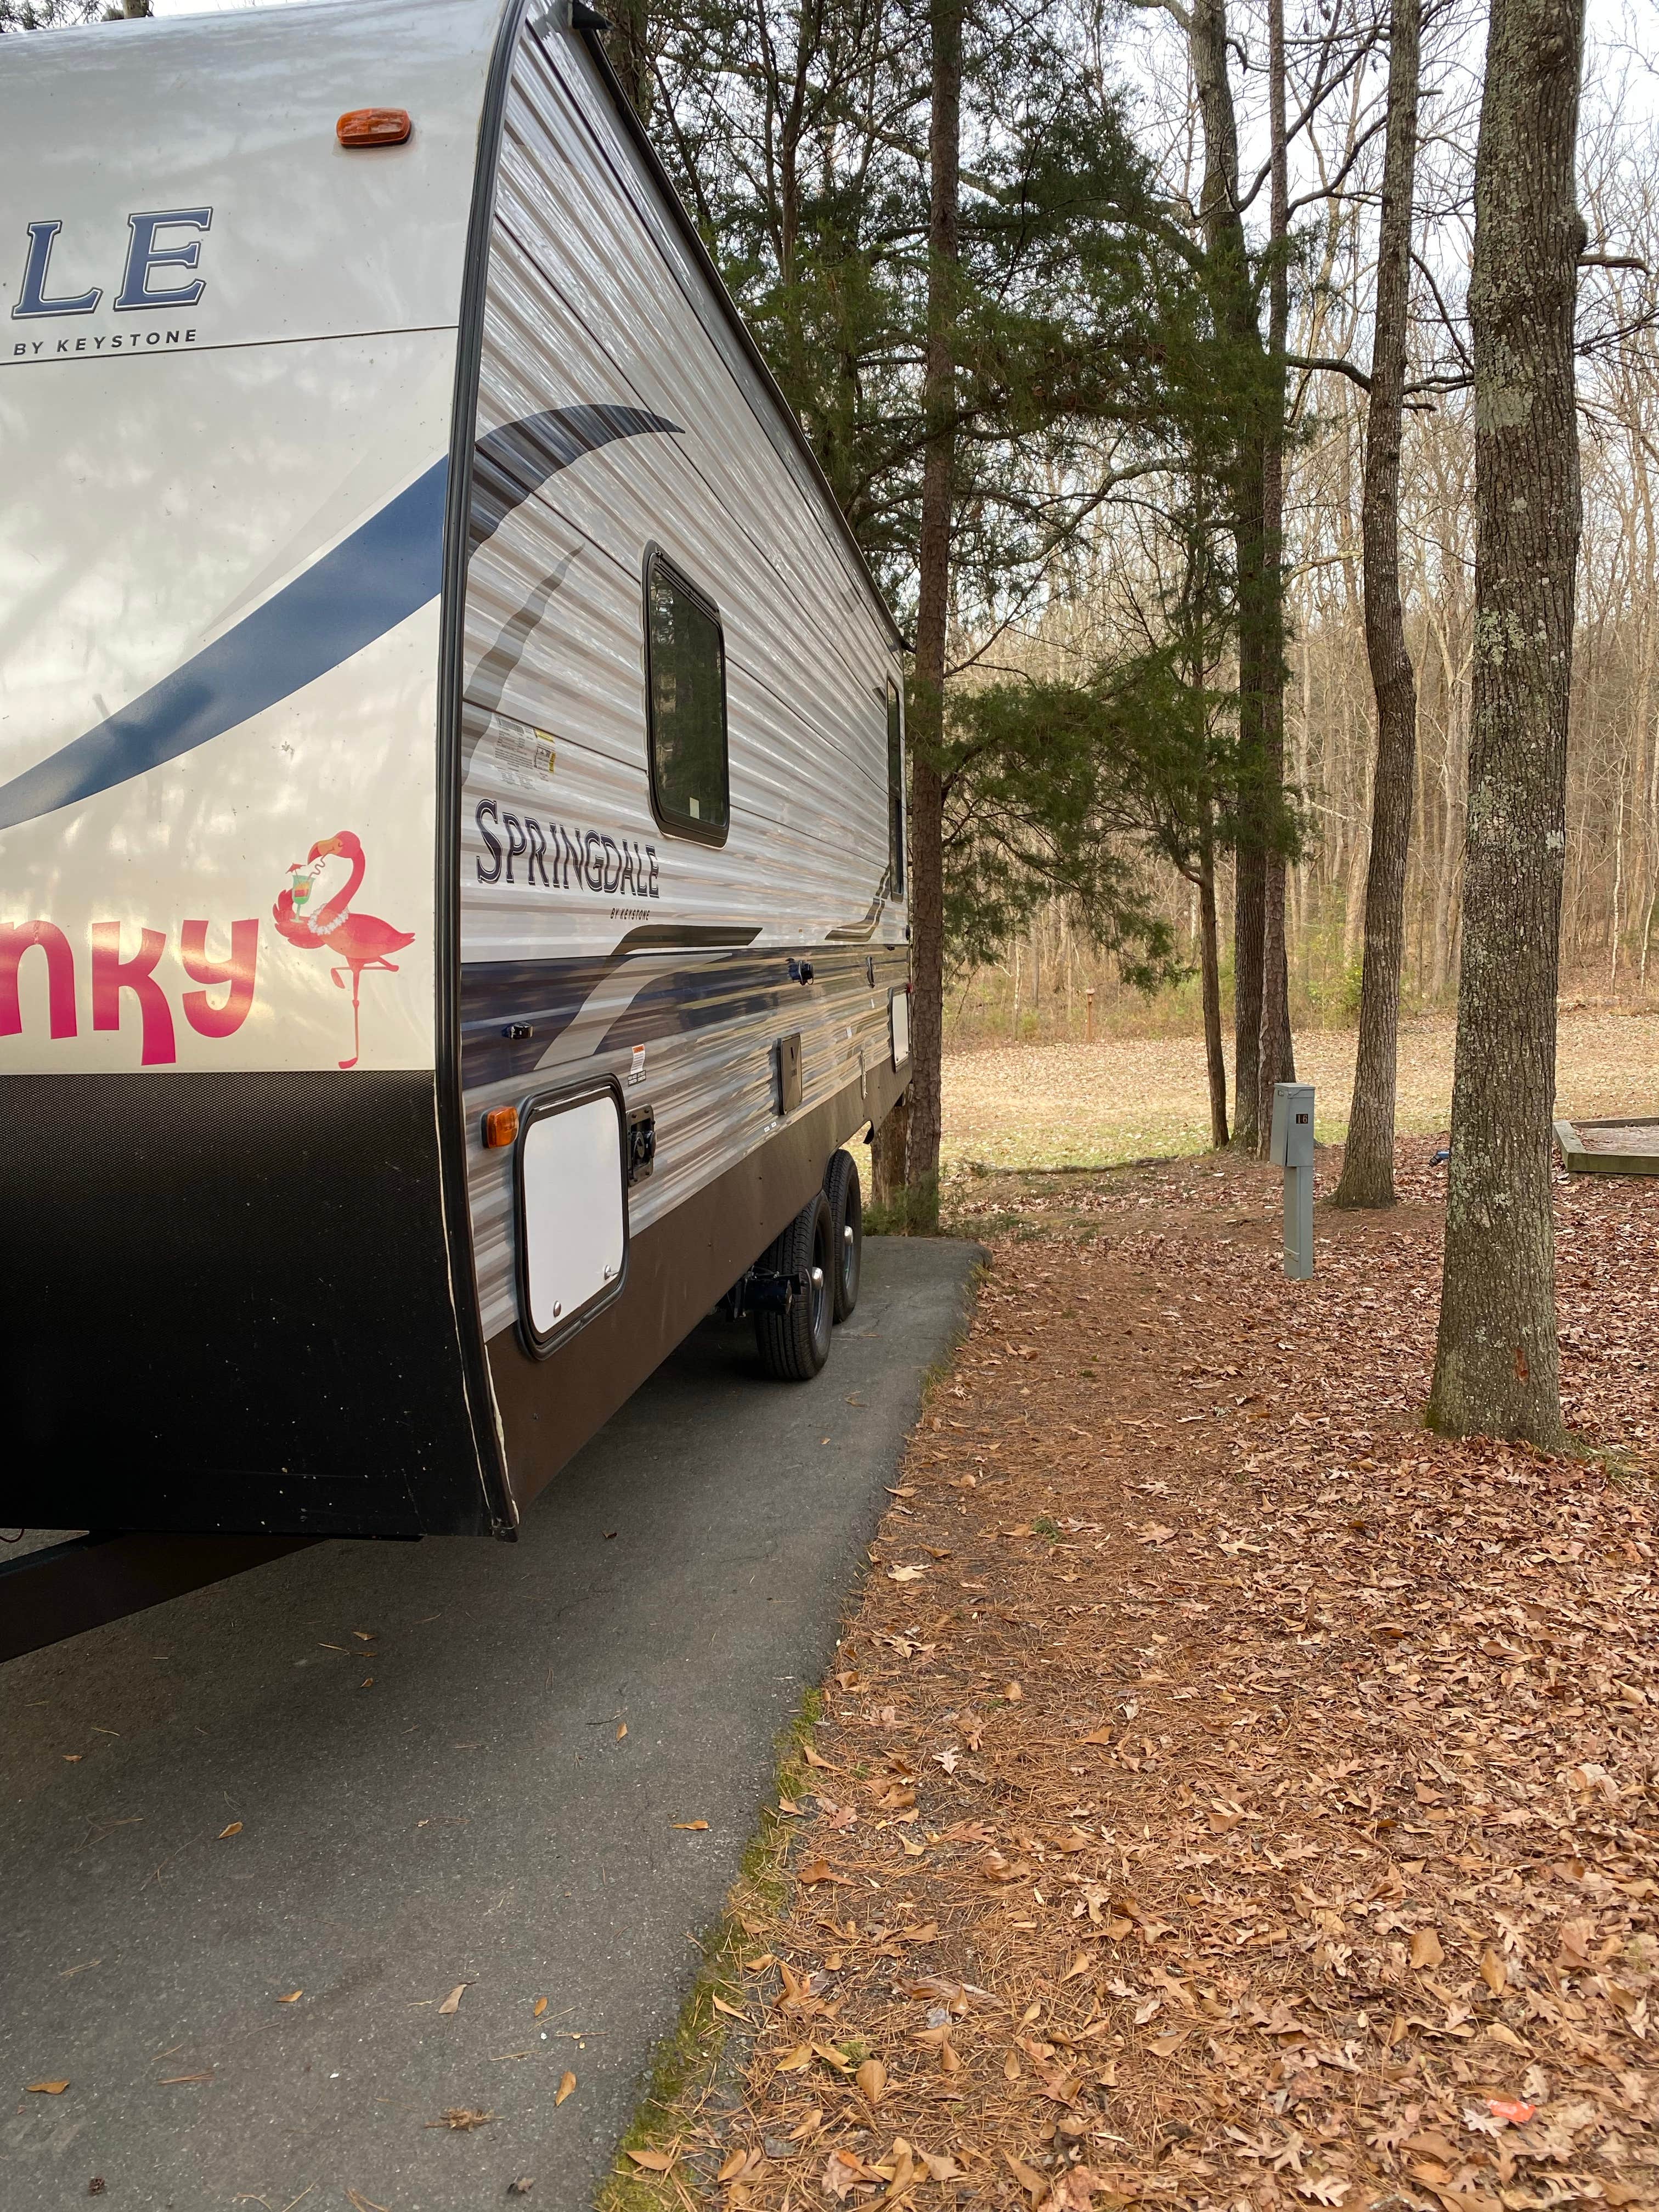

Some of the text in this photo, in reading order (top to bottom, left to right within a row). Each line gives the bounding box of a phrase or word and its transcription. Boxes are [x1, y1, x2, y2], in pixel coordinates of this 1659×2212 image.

[11, 206, 213, 319] LE
[14, 329, 196, 356] BY KEYSTONE
[476, 799, 659, 898] SPRINGDALE
[610, 907, 650, 921] BY KEYSTONE
[1297, 1114, 1307, 1124] 16
